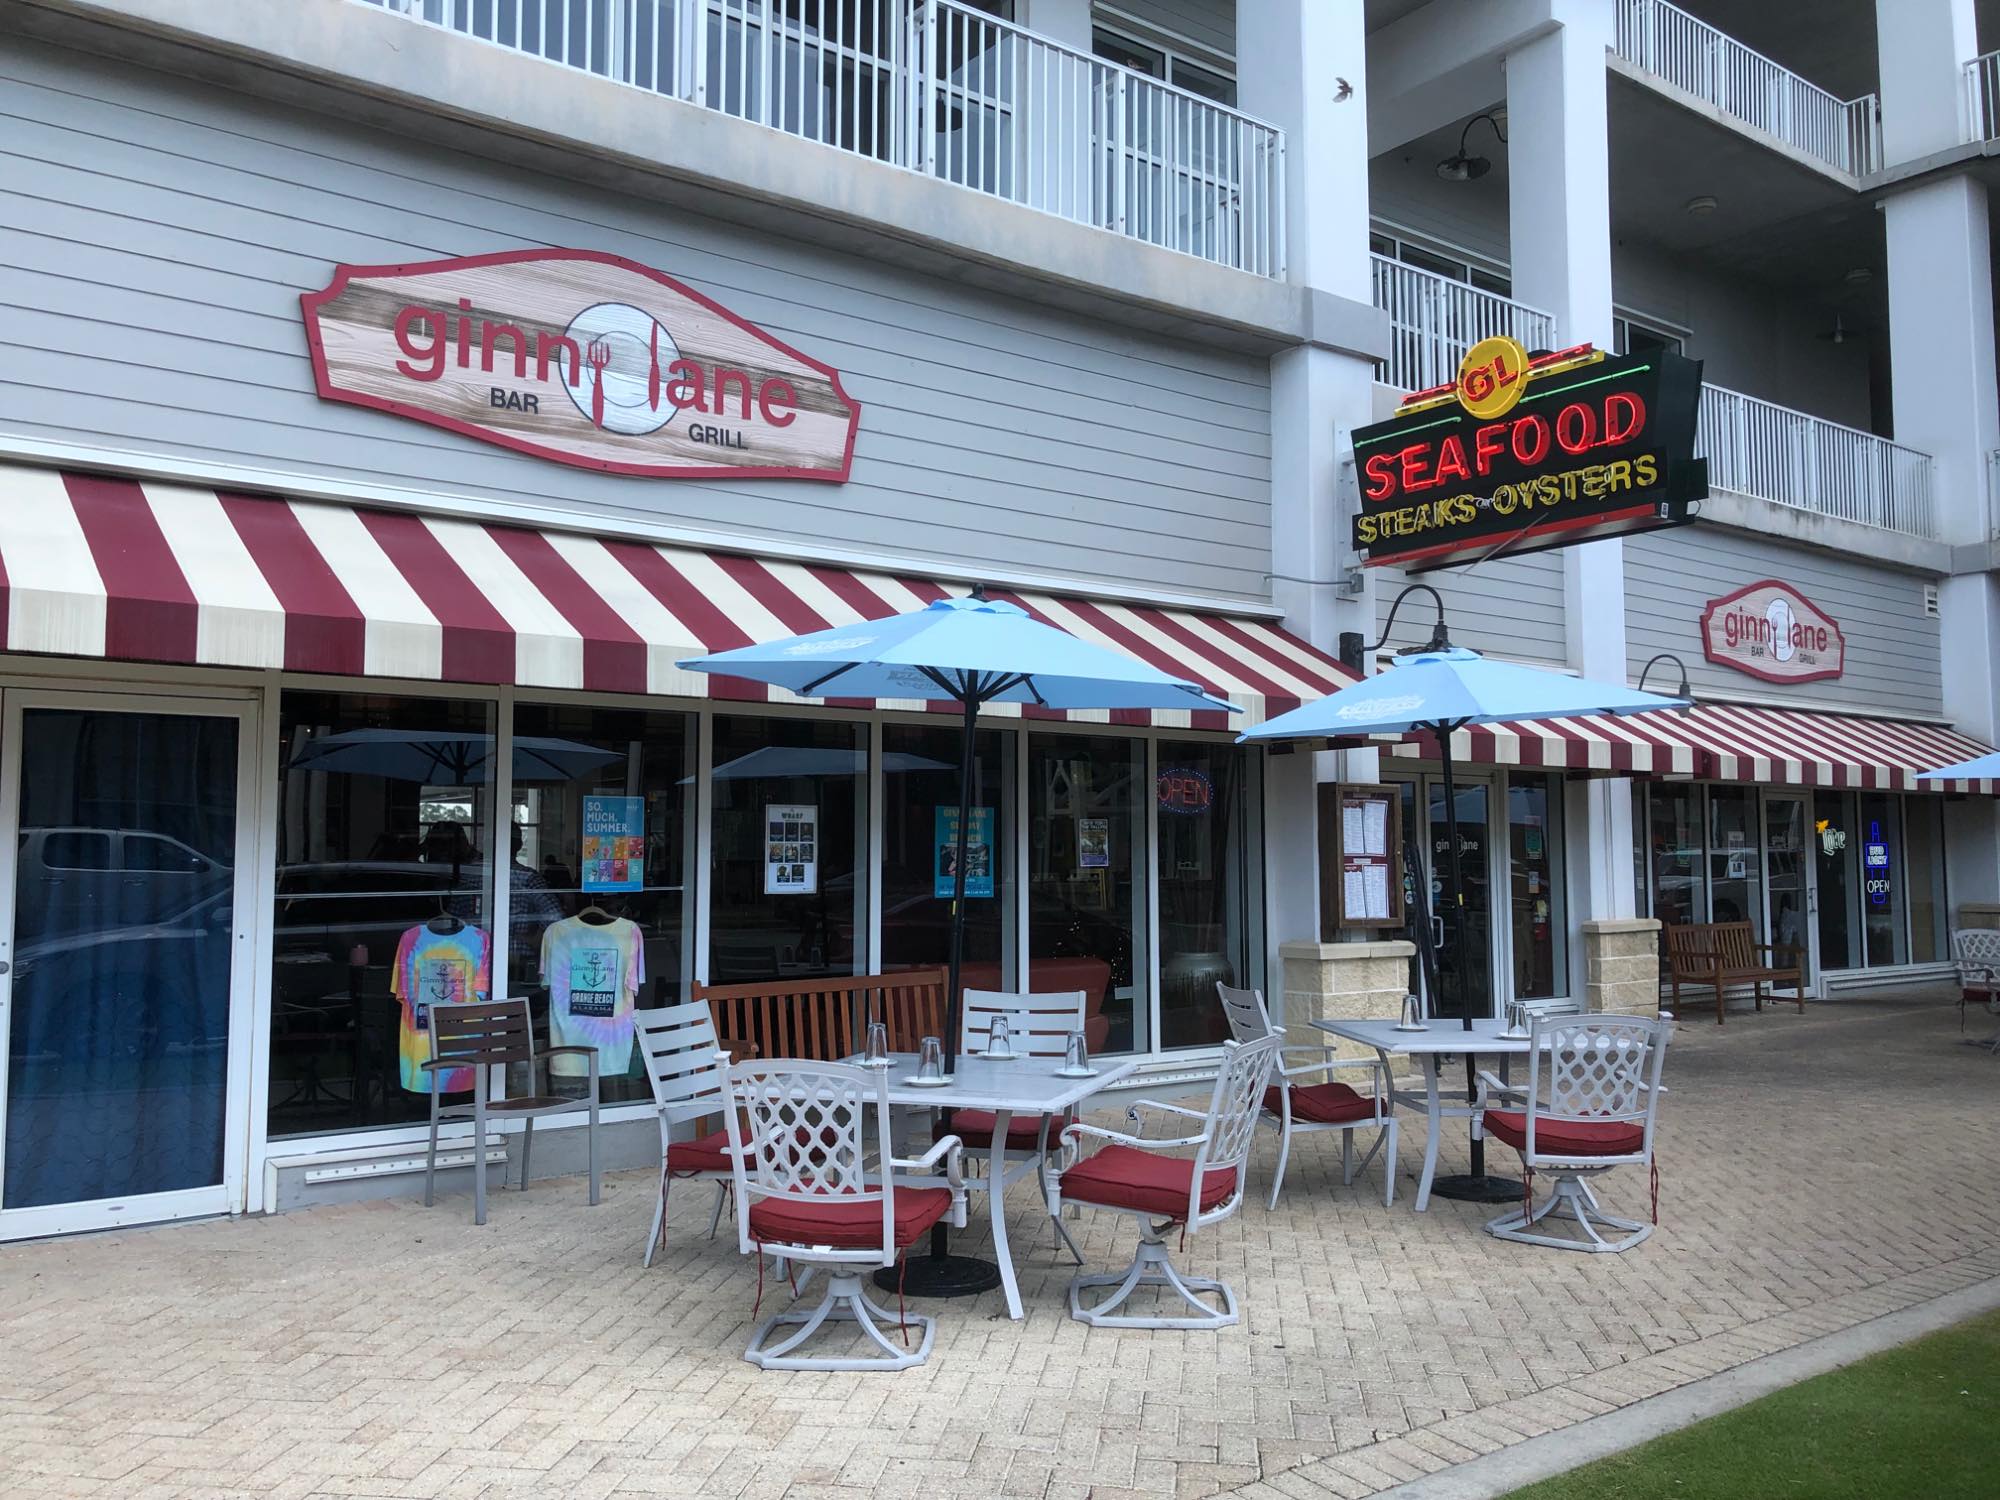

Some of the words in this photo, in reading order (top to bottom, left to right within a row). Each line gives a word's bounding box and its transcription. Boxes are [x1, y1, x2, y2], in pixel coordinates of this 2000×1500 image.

[1464, 355, 1518, 402] GL
[490, 387, 539, 415] BAR
[688, 423, 748, 450] GRILL
[1365, 392, 1646, 500] SEAFOOD
[1358, 494, 1476, 543] STEAKS
[1751, 646, 1764, 657] BAR
[1158, 777, 1209, 804] OPEN
[1867, 880, 1890, 893] OPEN
[571, 992, 594, 1003] ORANGE
[594, 993, 614, 1004] BEACH
